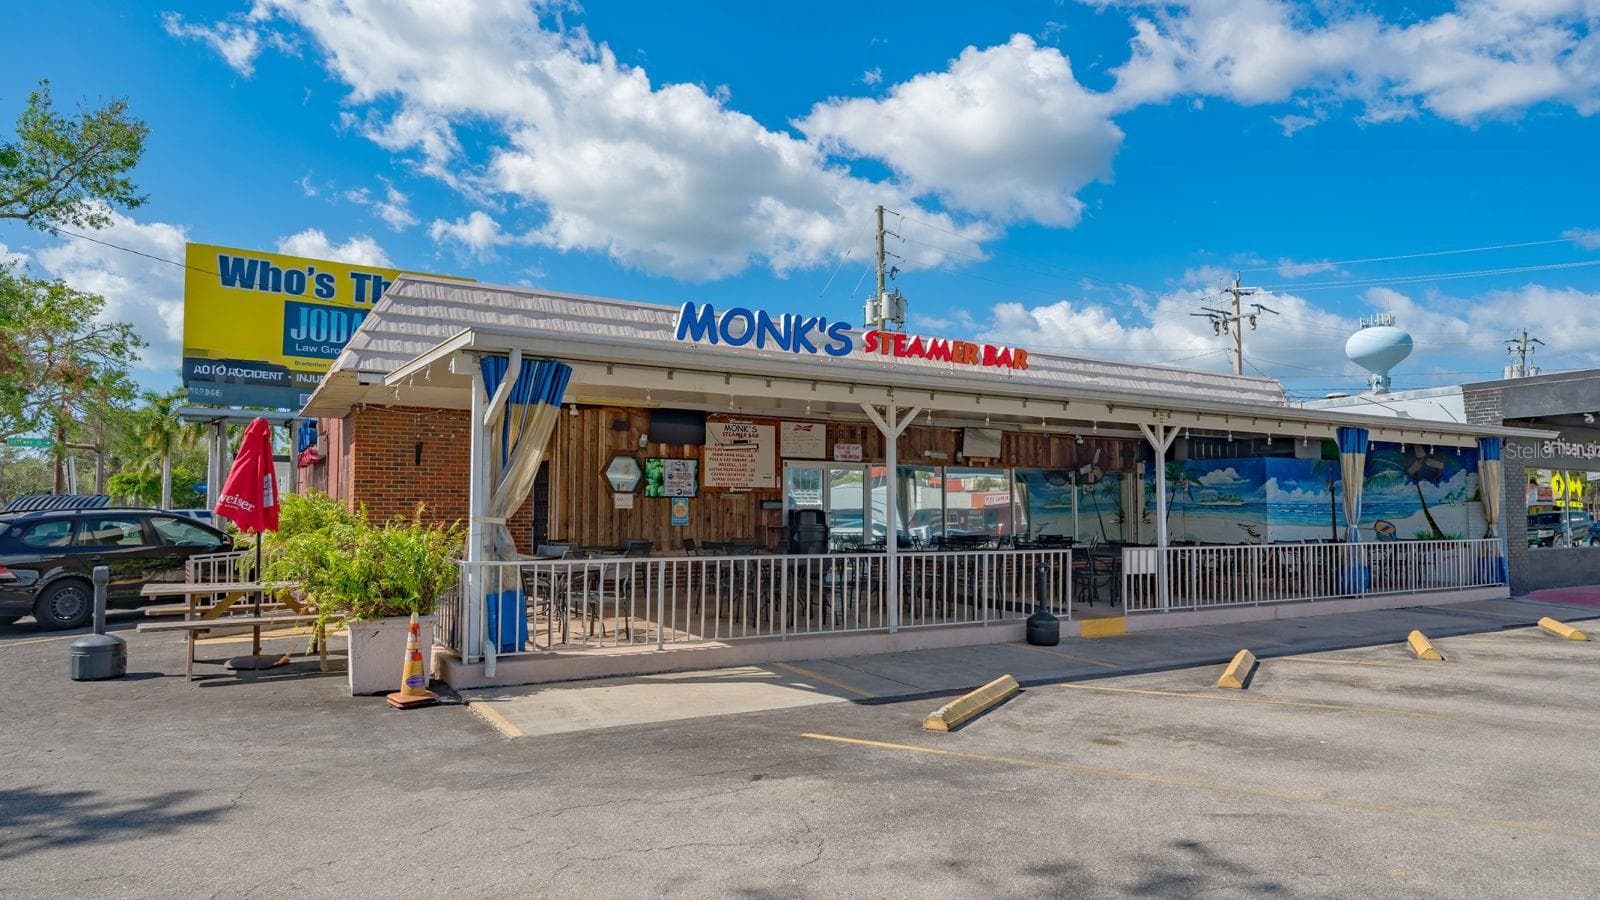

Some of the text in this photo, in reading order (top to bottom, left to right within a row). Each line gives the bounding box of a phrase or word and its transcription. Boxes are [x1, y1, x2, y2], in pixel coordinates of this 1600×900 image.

[217, 254, 336, 300] Who's
[676, 301, 1029, 370] MONK'S STEAMER BAR
[295, 343, 318, 353] Law
[294, 360, 327, 368] Bradenton
[228, 367, 284, 381] ACCIDENT
